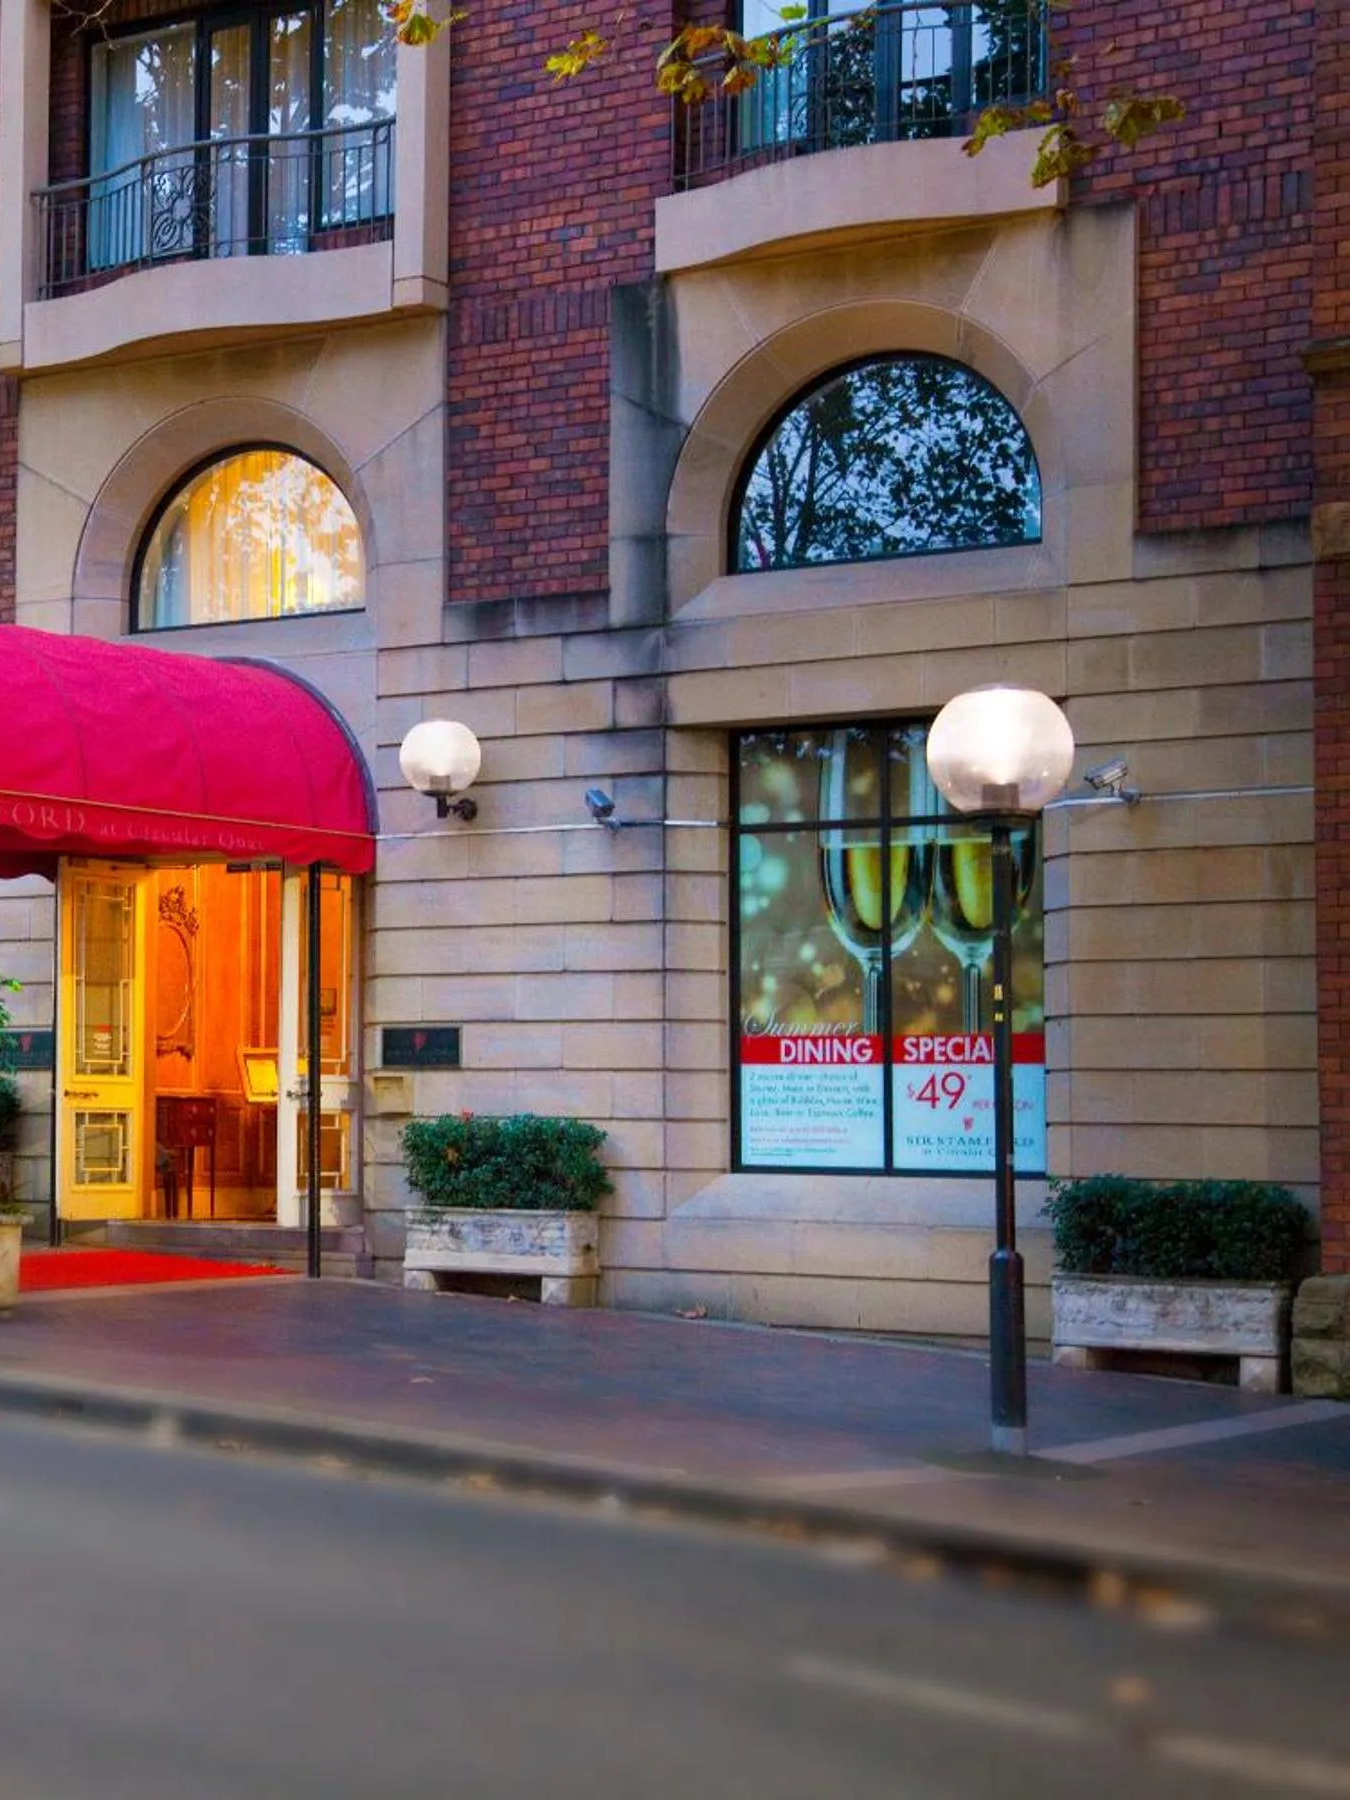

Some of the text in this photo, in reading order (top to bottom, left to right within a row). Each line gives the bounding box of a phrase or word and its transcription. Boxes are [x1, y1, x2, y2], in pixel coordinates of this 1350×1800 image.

[744, 1010, 858, 1037] Summer
[780, 1036, 995, 1062] DINING SPECIA
